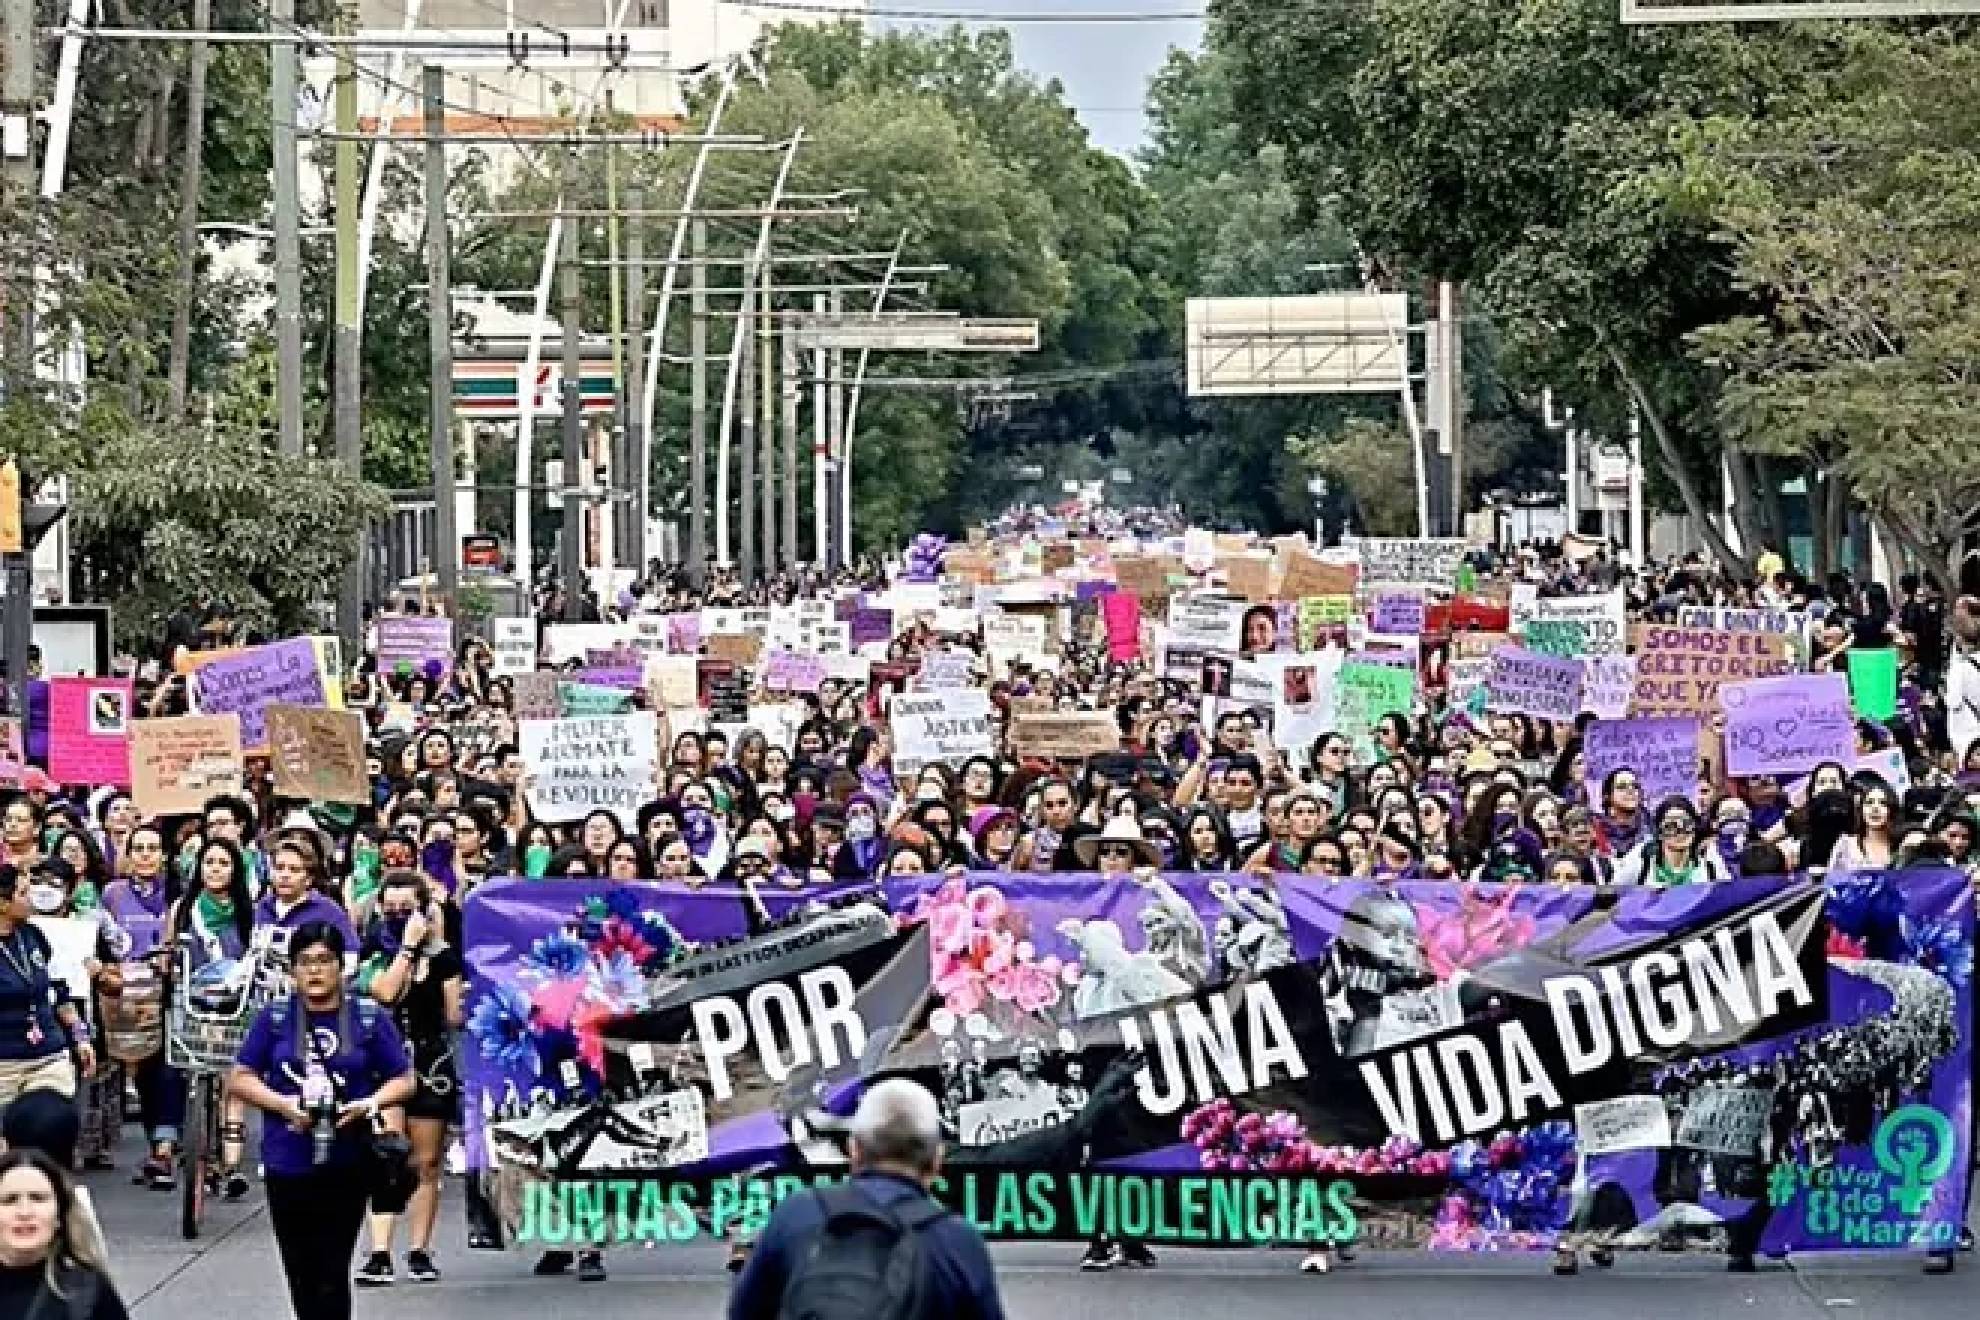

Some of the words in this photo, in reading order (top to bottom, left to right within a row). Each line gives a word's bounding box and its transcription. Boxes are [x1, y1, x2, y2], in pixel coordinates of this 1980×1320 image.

[1637, 652, 1724, 677] GRITO
[1645, 626, 1732, 656] SOMOS
[1737, 634, 1771, 656] EL
[1636, 679, 1689, 702] QUE
[692, 965, 867, 1102] POR
[1119, 979, 1309, 1117] UNA
[1359, 1019, 1565, 1145] VIDA
[1543, 911, 1813, 1077] DIGNA
[517, 1179, 698, 1245] JUNTAS
[963, 1172, 1057, 1233] LAS
[1070, 1174, 1358, 1244] VIOLENCIAS
[1842, 1186, 1885, 1214] de
[1843, 1216, 1954, 1245] Marzo
